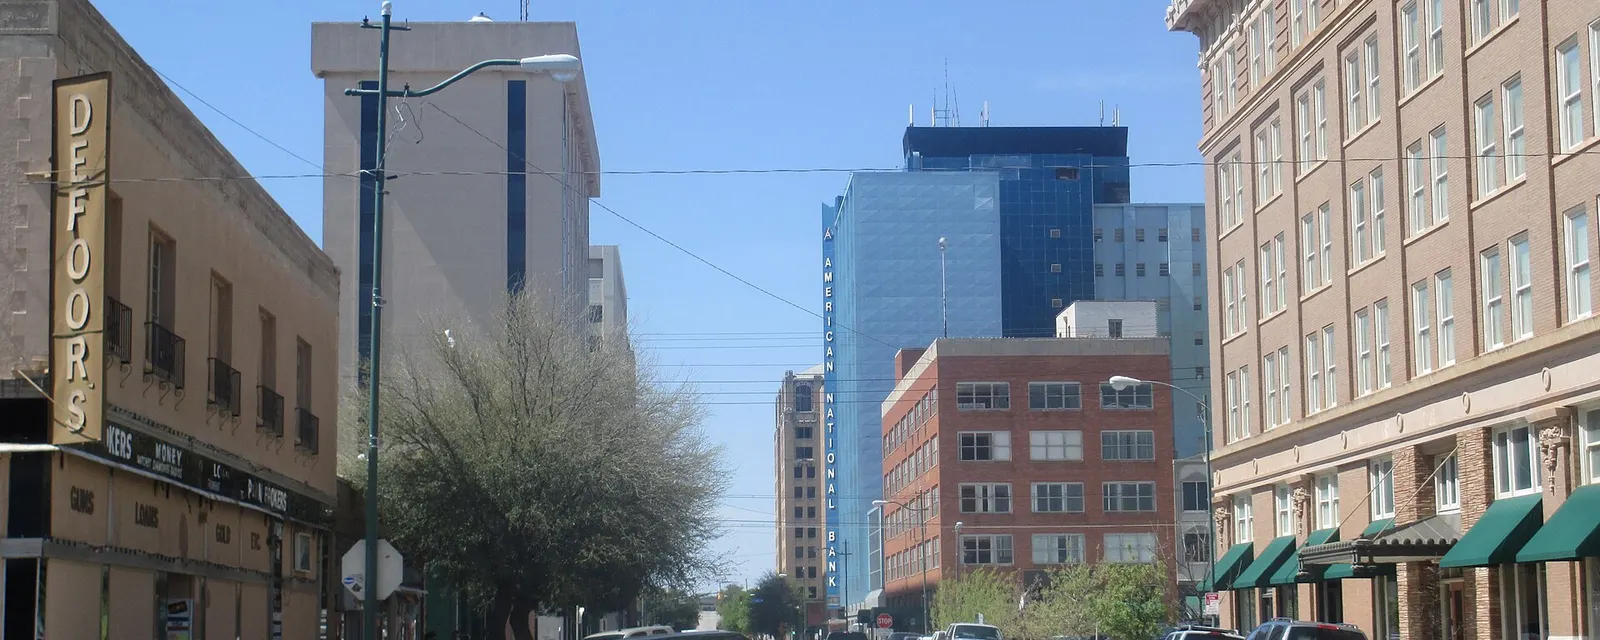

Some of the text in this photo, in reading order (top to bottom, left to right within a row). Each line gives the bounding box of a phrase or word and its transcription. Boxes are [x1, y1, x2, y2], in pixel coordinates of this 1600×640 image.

[824, 257, 837, 587] AMERICAN NATIONAL BANK
[155, 442, 183, 466] MONEY
[71, 485, 95, 515] GUNS
[135, 501, 159, 528] LOANS
[215, 523, 231, 545] GOLD
[878, 617, 891, 625] STOP
